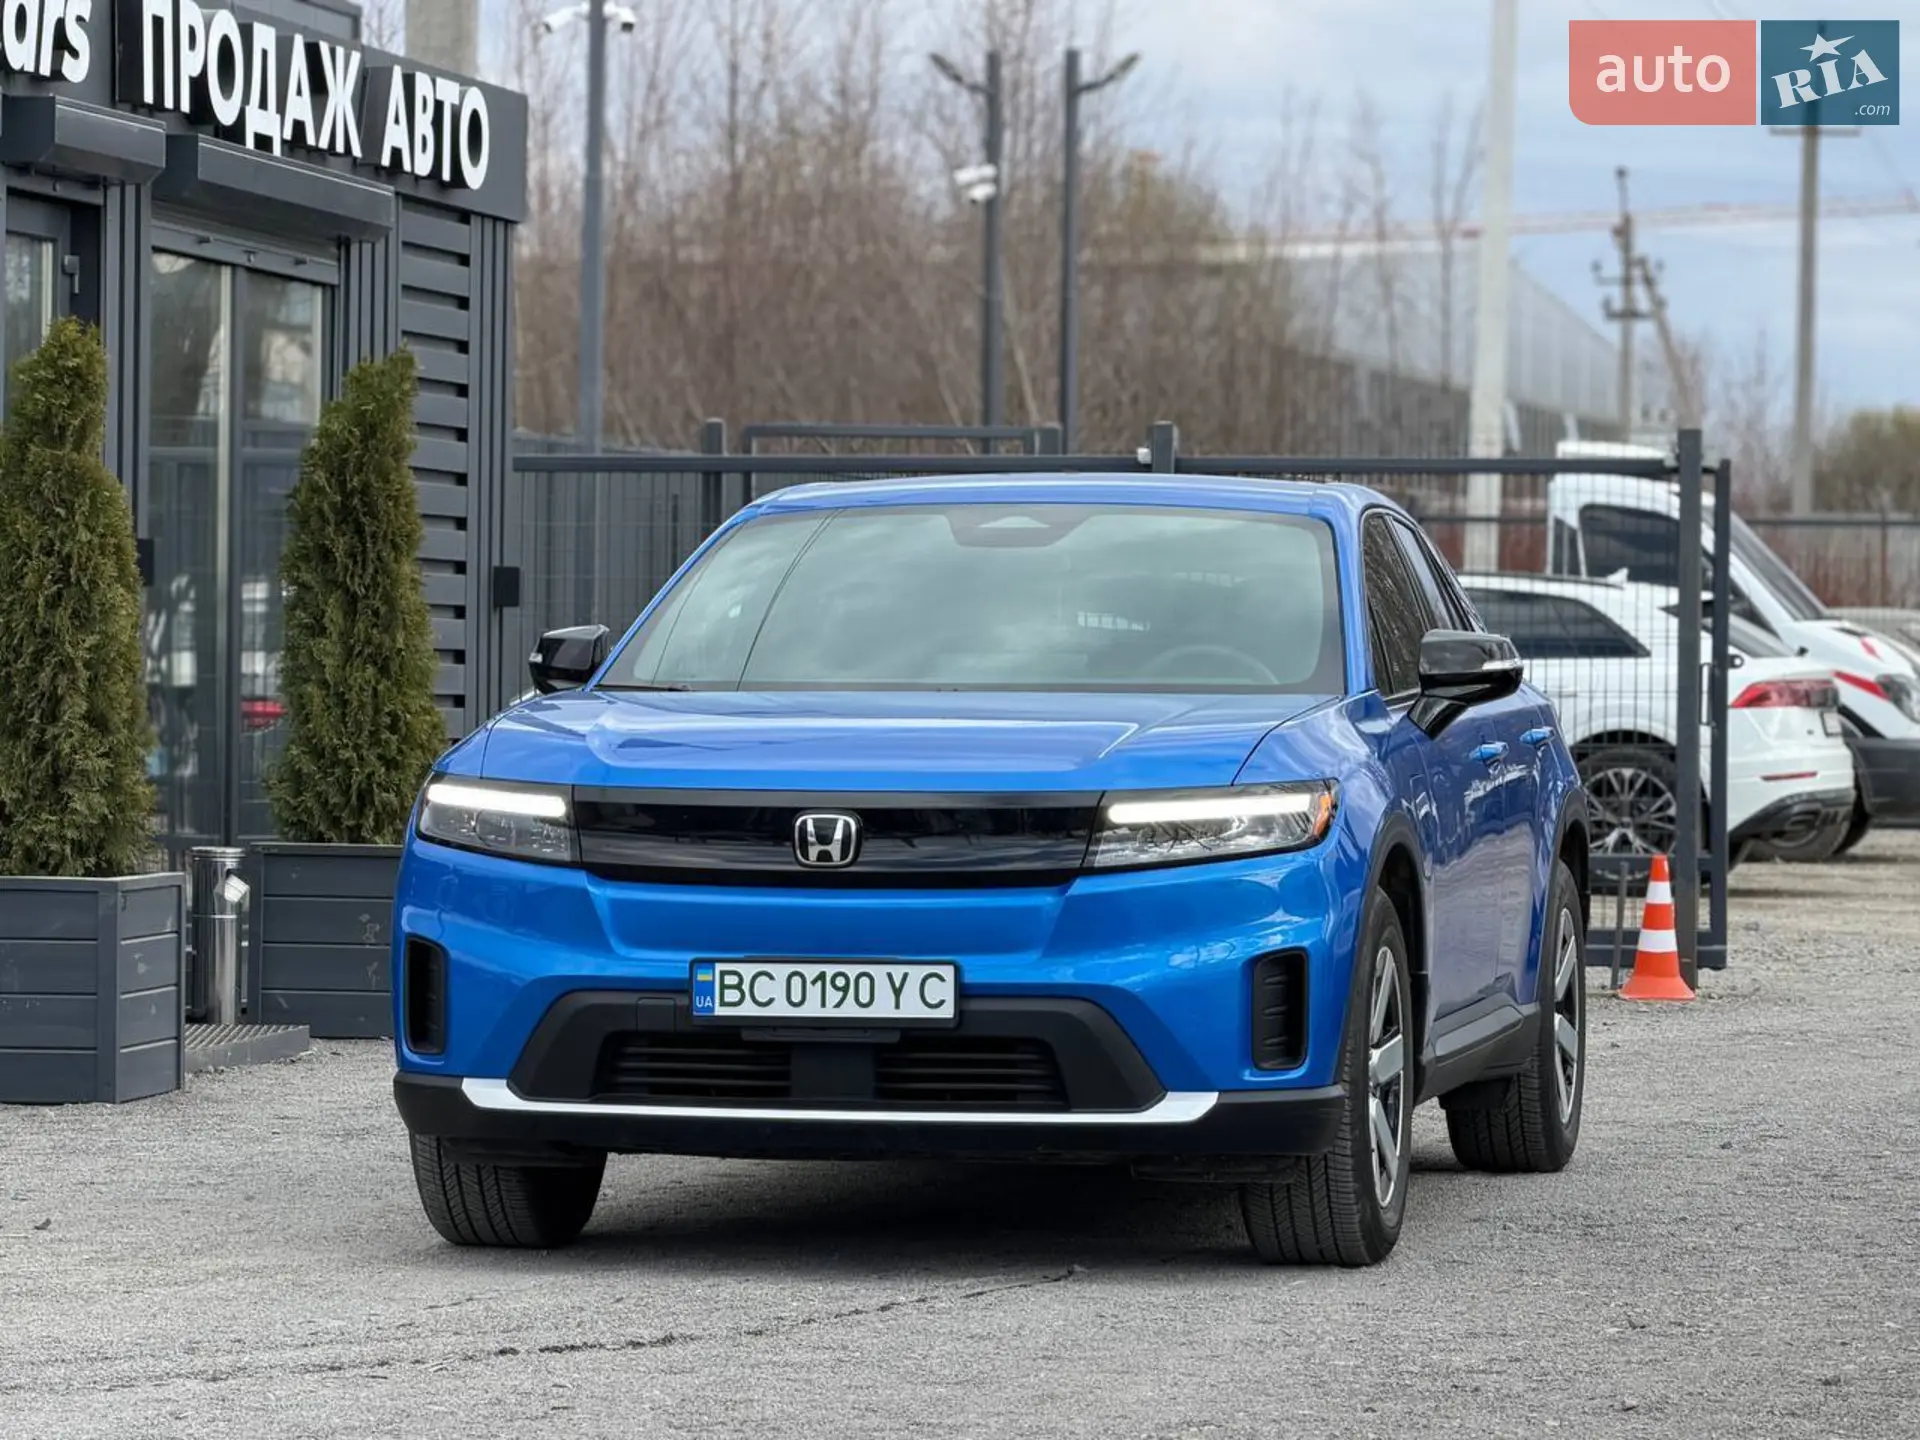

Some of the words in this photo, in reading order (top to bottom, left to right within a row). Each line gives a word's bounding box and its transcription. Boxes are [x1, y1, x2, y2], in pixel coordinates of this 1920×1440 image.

[142, 0, 364, 159] ПРОДАЖ
[380, 63, 491, 191] АВТО
[695, 995, 713, 1009] UA
[785, 970, 876, 1009] 0190
